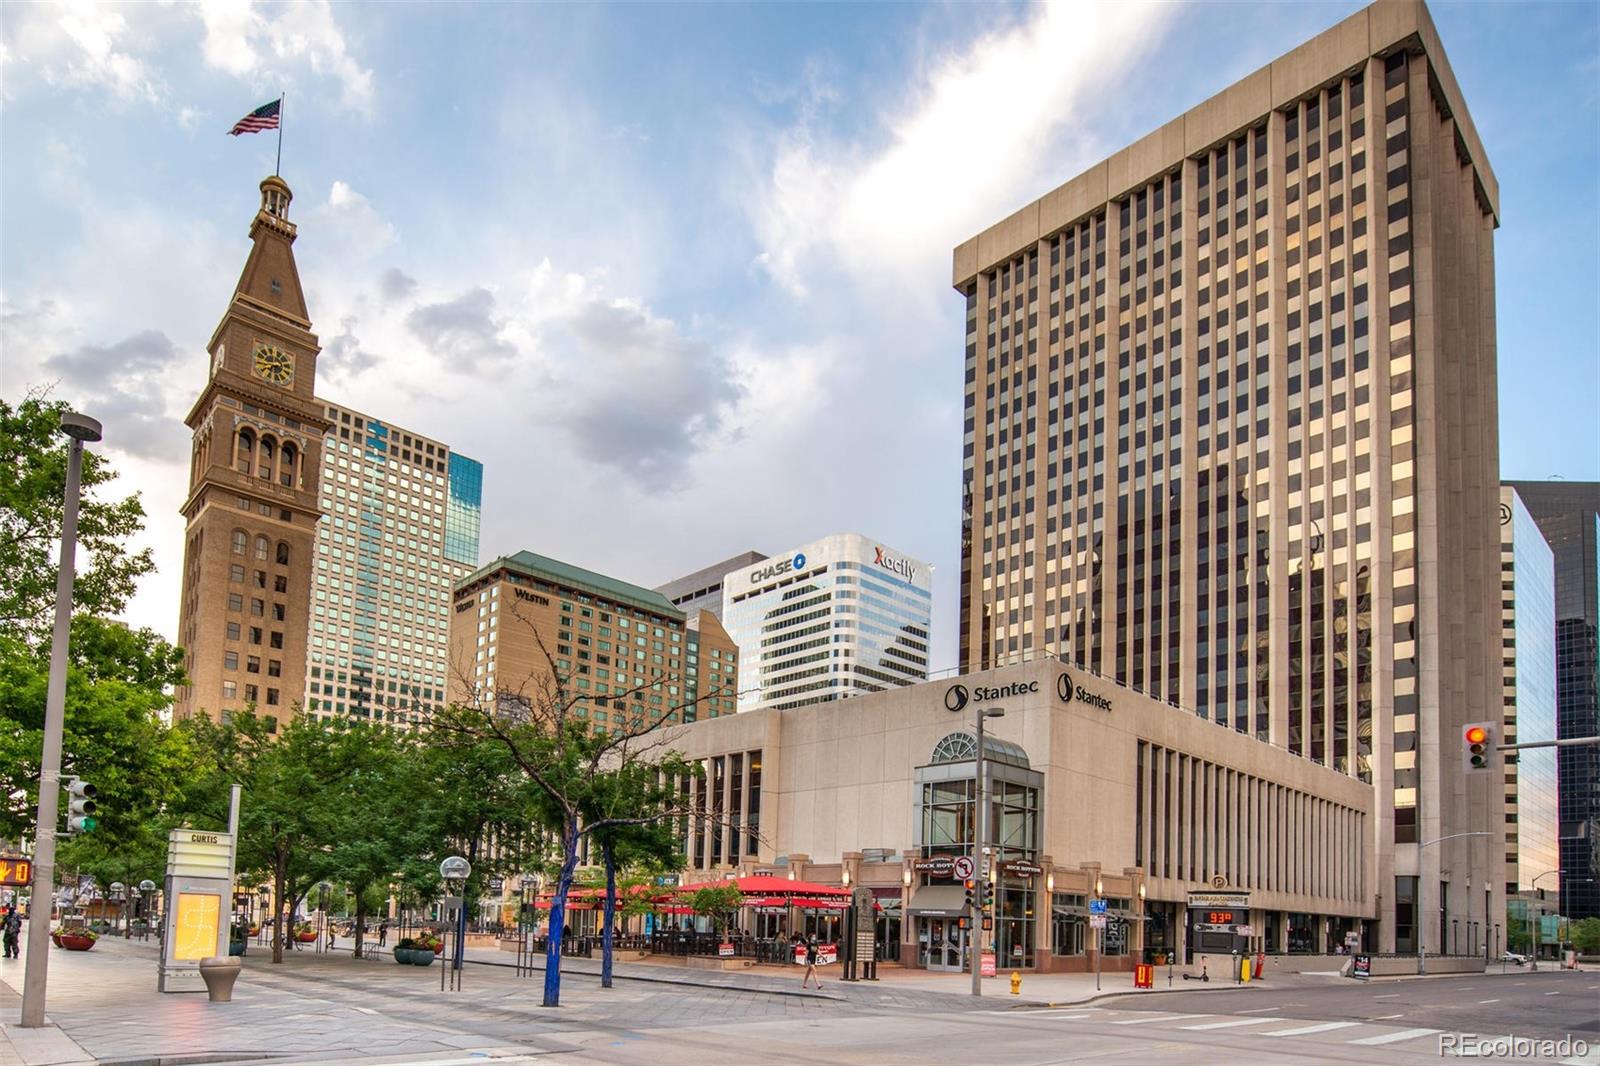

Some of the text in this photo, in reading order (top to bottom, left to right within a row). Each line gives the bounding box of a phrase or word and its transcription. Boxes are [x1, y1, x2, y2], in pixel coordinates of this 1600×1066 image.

[750, 558, 793, 584] CHASE
[514, 587, 550, 606] WESTIN
[973, 680, 1039, 702] Stantec
[1075, 685, 1113, 712] Stantec
[191, 834, 218, 844] CURTIS
